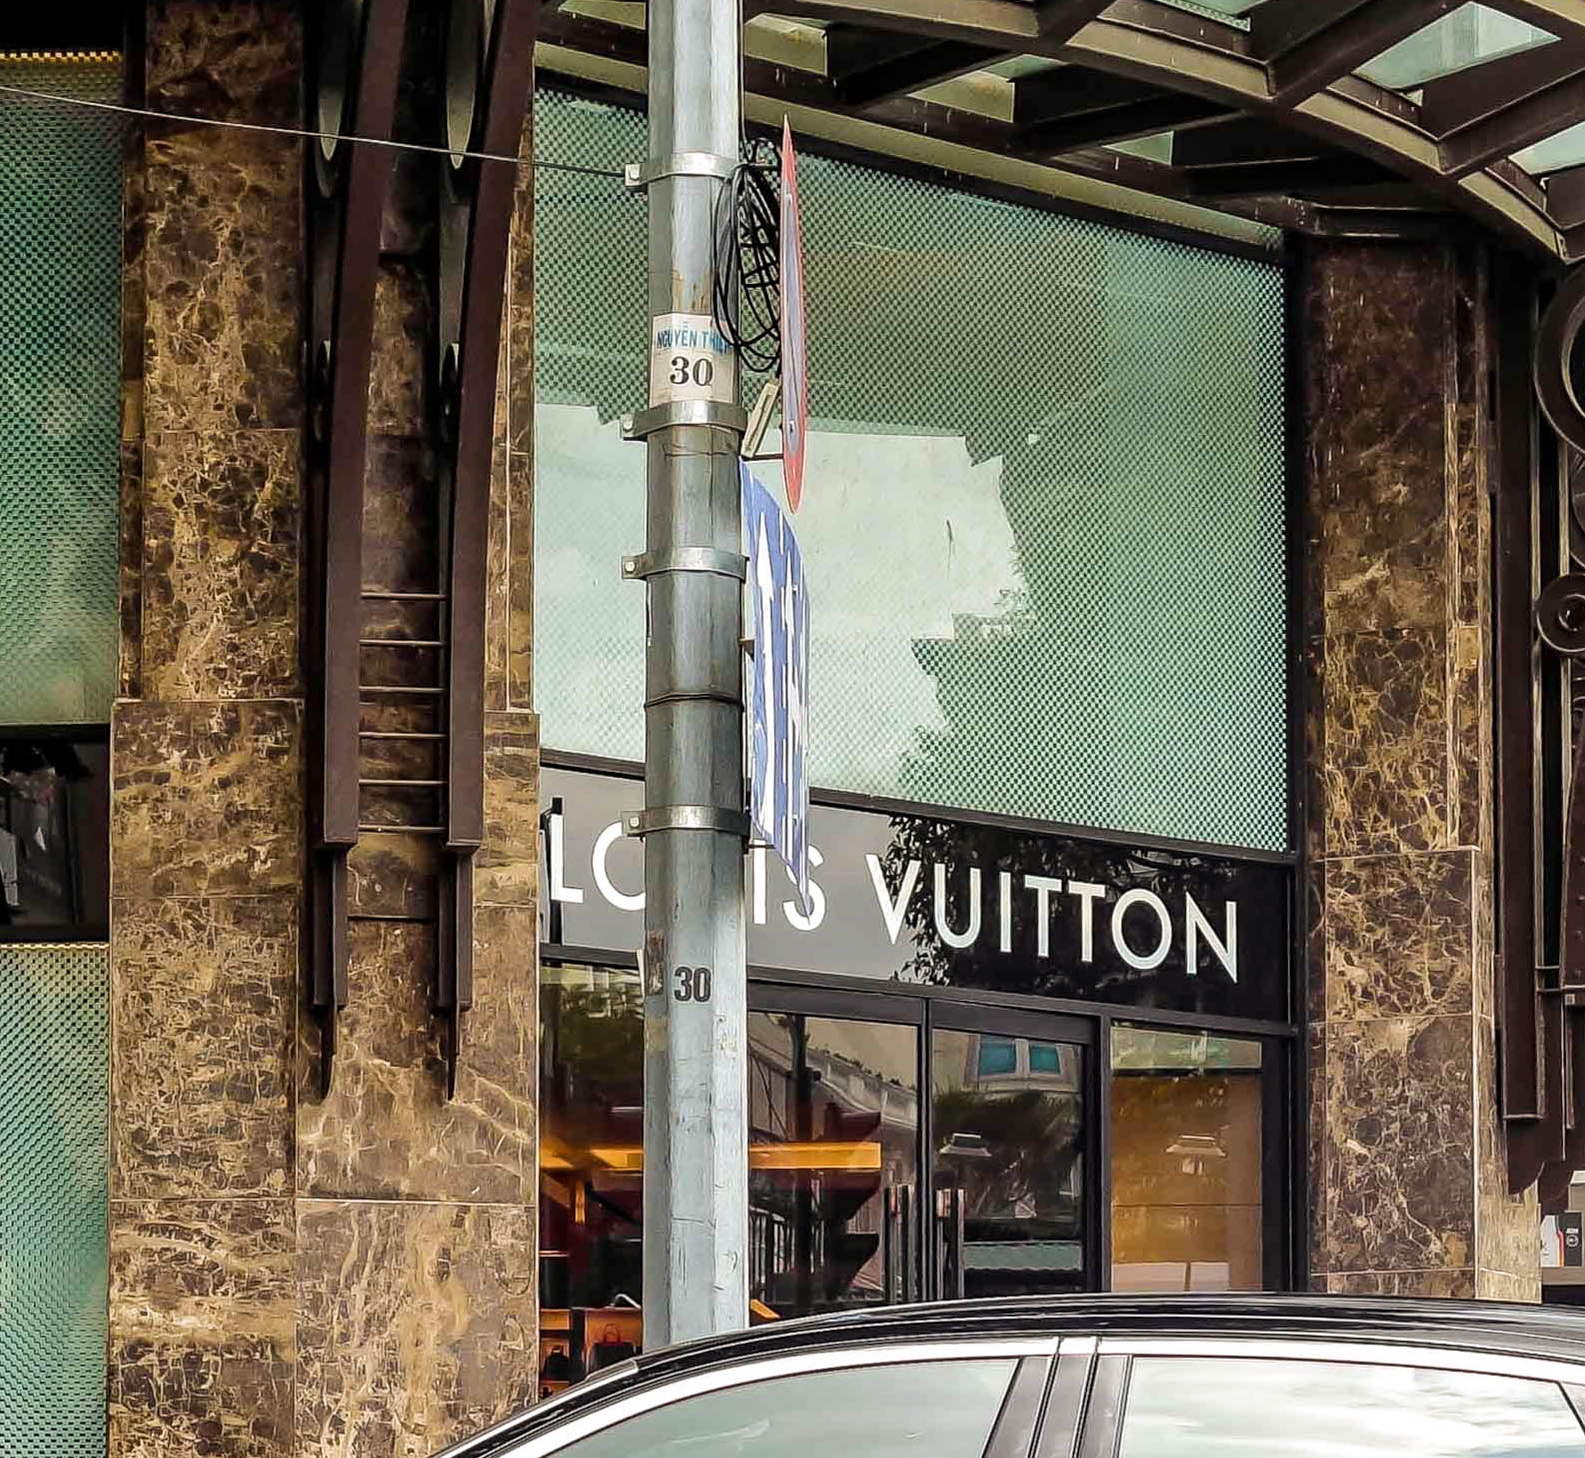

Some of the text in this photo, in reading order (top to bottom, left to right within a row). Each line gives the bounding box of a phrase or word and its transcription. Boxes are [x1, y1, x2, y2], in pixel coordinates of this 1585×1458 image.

[670, 356, 714, 387] 30
[550, 813, 1239, 984] LOIS VUITTON
[673, 966, 712, 1003] 30
